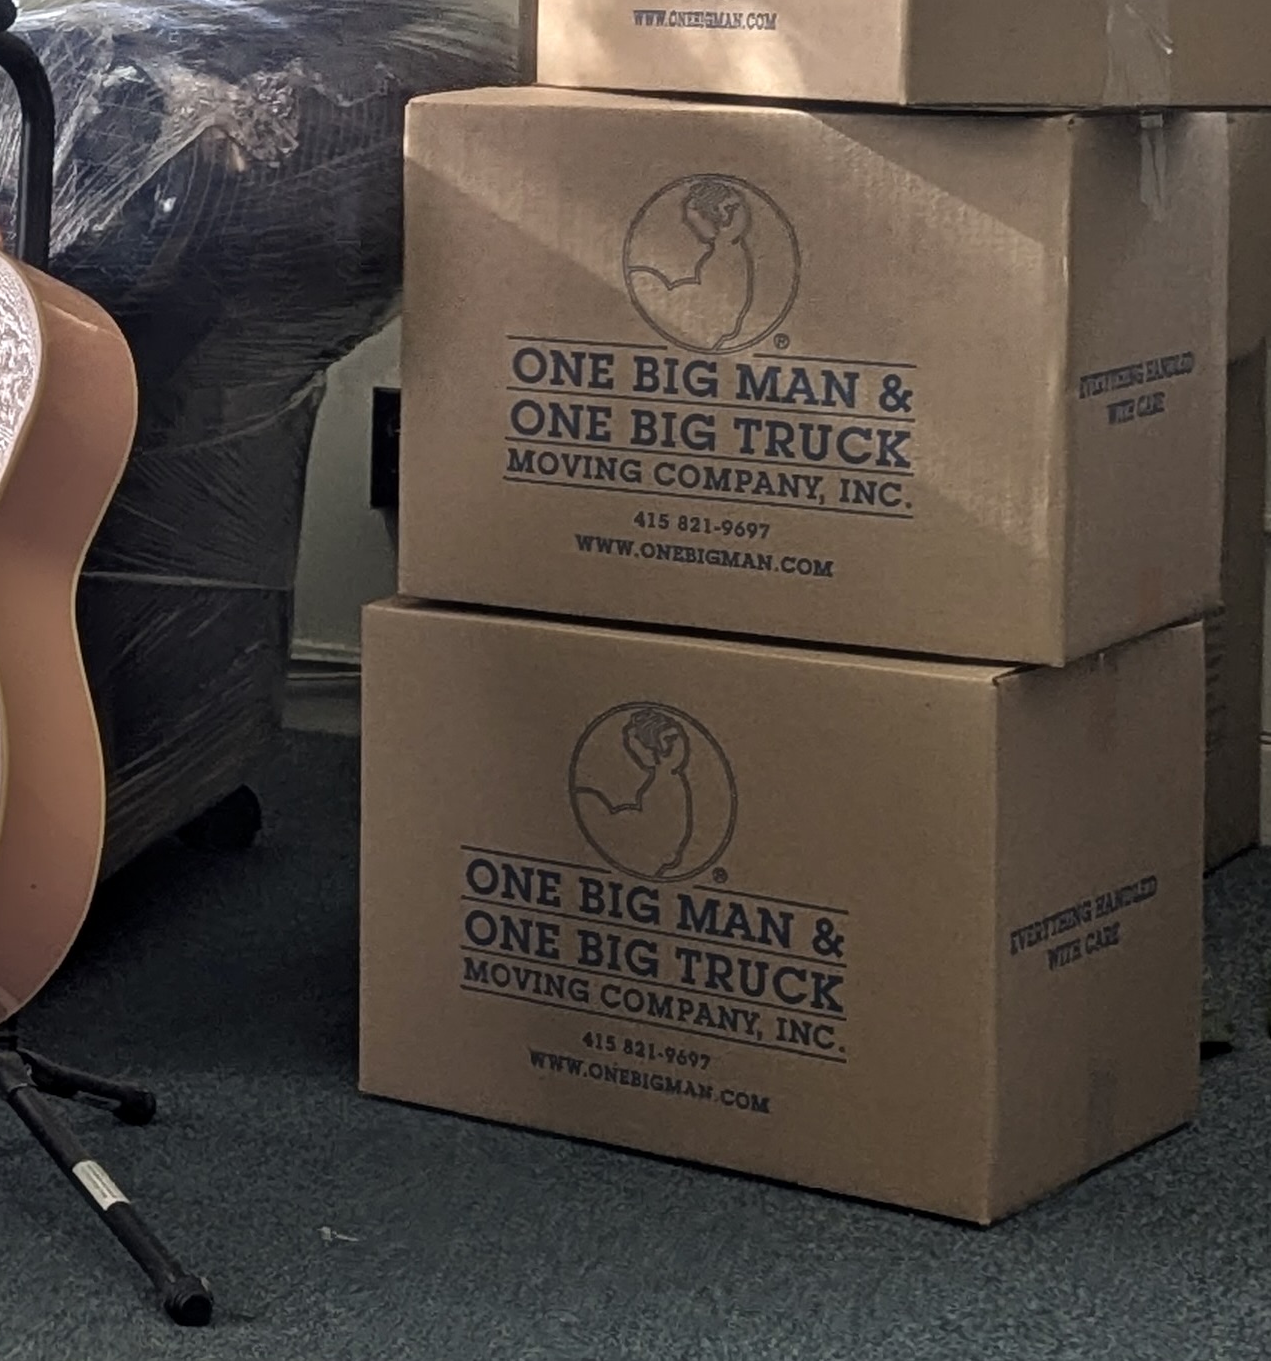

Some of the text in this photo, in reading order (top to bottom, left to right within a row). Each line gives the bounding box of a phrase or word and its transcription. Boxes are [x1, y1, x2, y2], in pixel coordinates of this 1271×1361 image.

[512, 347, 913, 414] ONE BIG MAN &
[510, 399, 912, 469] ONE BIG TRUCK
[506, 448, 913, 509] MOVING COMPANY, INC.
[575, 534, 834, 578] WWW.ONEBIGMAN.COM
[634, 510, 771, 539] 415 821-9697
[466, 858, 846, 959] ONE BIG MAN &
[465, 910, 844, 1013] ONE BIG TRUCK
[463, 957, 846, 1053] MOVING COMPANY, INC.
[529, 1048, 770, 1114] WWW.ONEBIGMAN.COM
[582, 1031, 712, 1070] 415 821-9697
